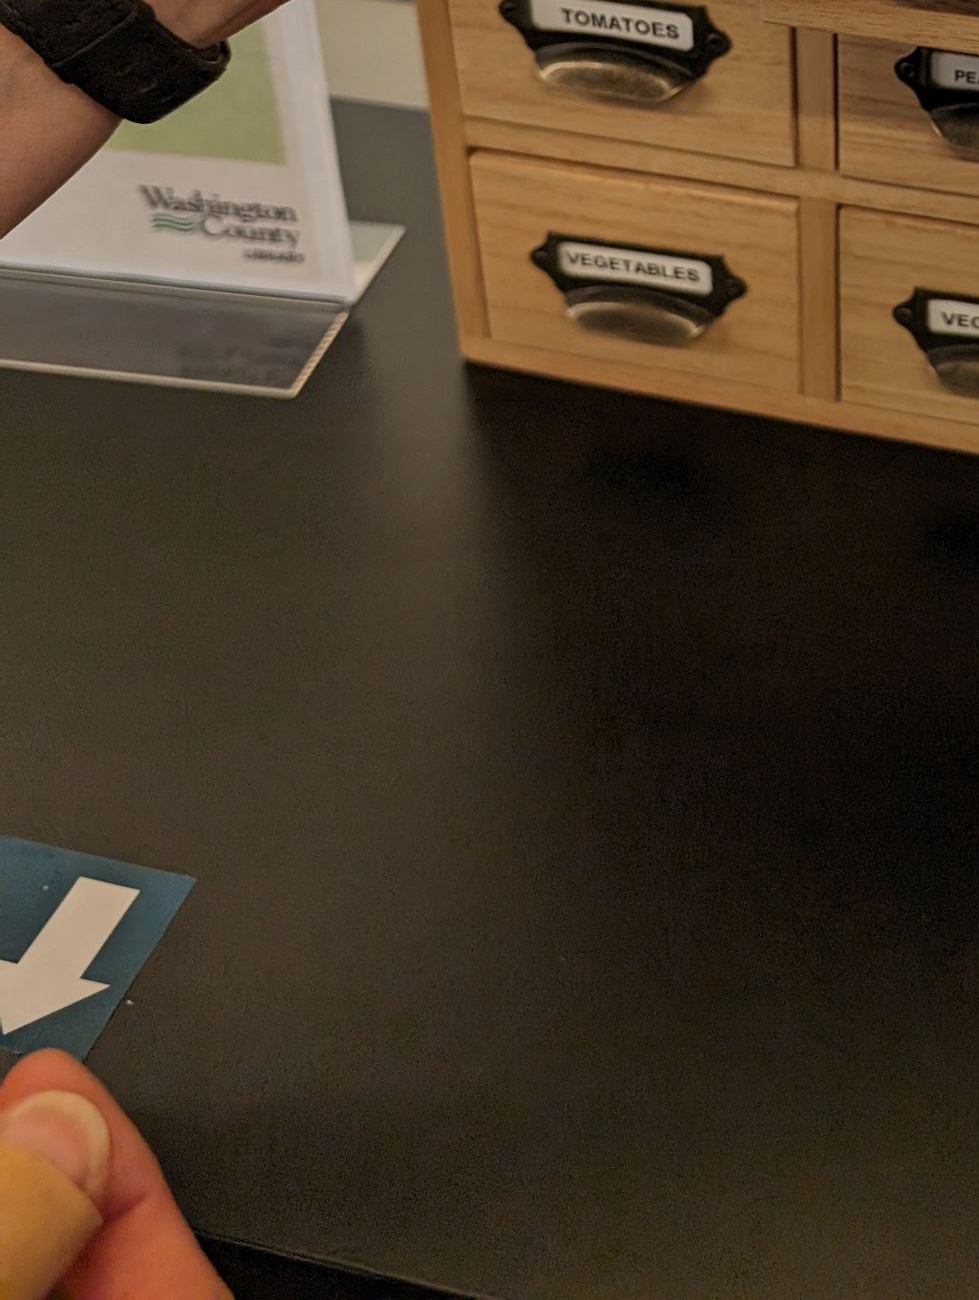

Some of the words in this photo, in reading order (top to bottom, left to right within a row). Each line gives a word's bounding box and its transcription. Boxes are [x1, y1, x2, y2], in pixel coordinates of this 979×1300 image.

[561, 7, 681, 40] TOMATOES
[138, 185, 298, 223] Washington
[201, 214, 300, 248] County
[566, 251, 701, 283] VEGETABLES
